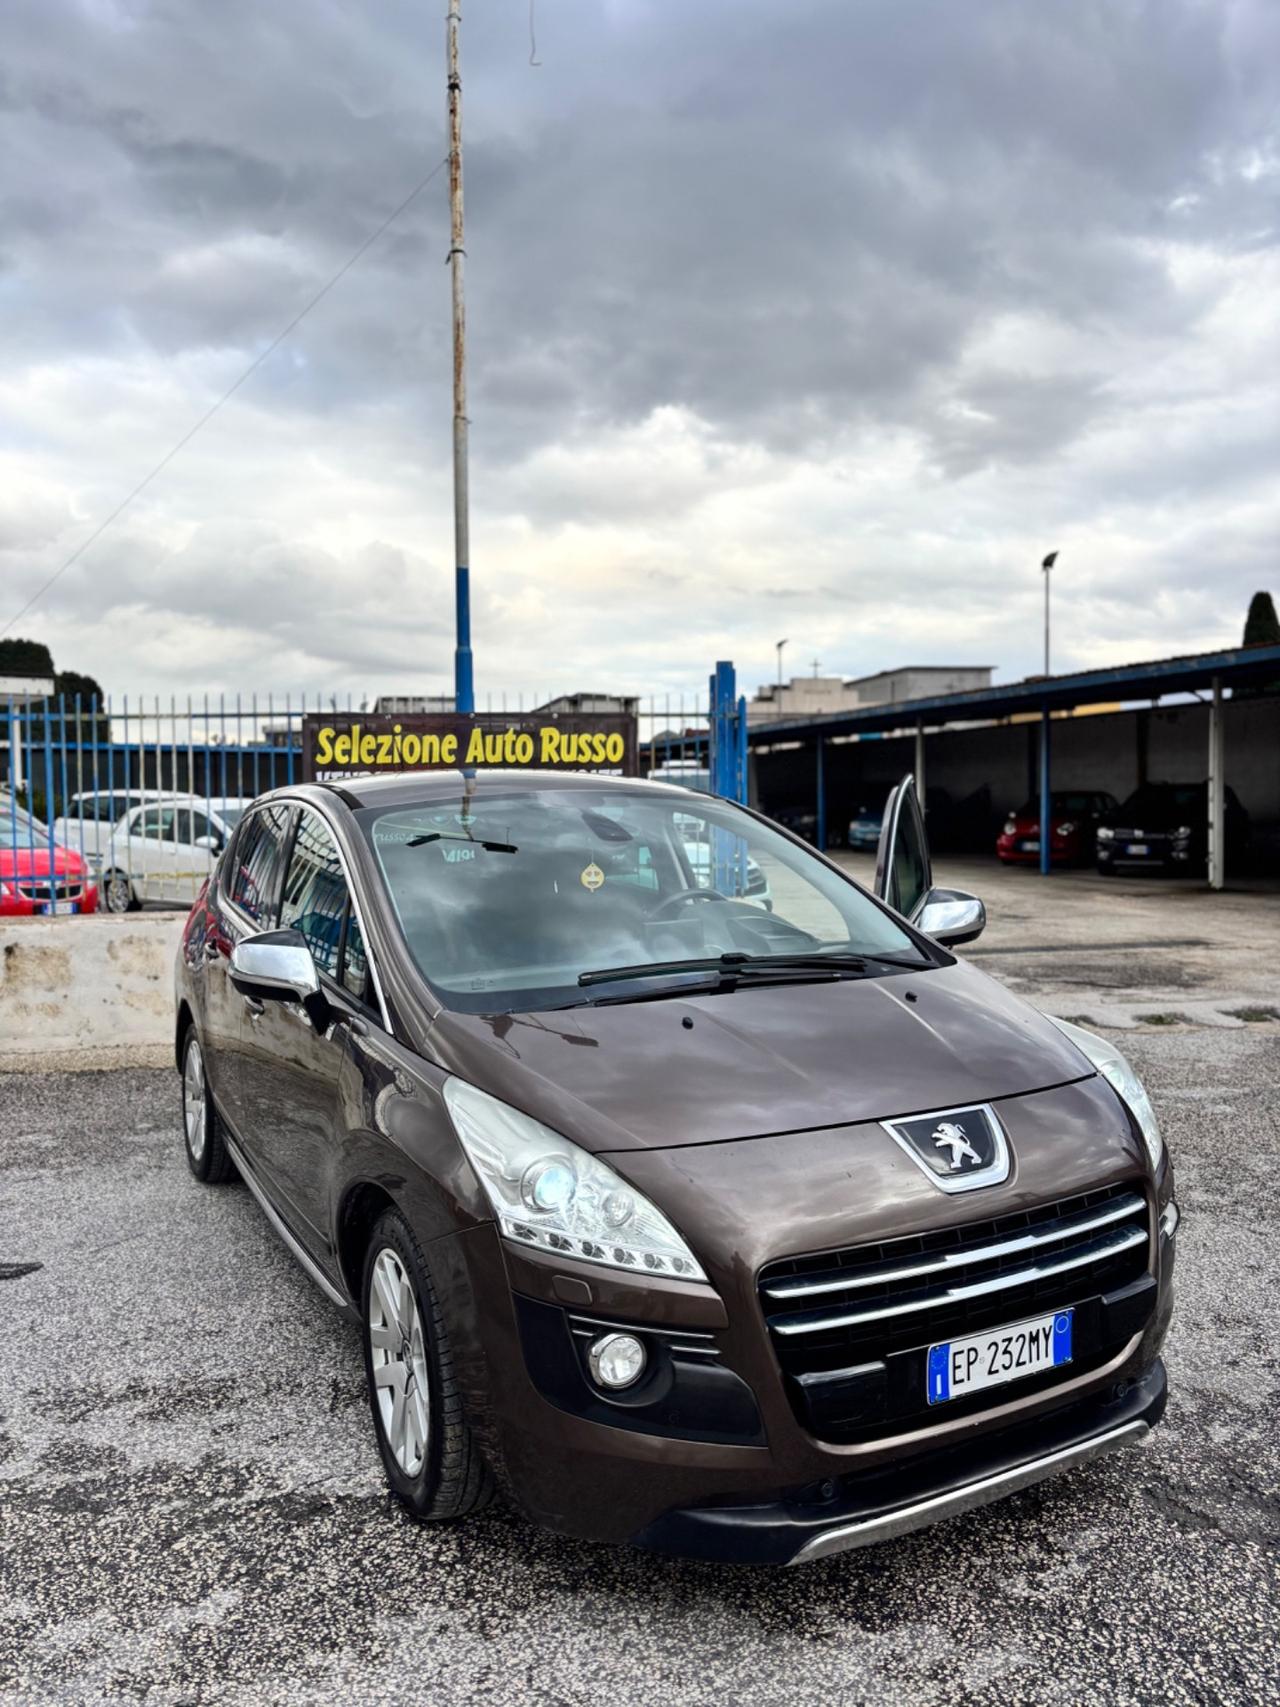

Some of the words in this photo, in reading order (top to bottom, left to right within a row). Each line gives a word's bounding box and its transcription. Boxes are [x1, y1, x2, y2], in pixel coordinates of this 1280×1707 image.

[315, 723, 457, 765] Selezione
[465, 727, 534, 765] Auto
[540, 726, 625, 763] Russo
[953, 1347, 978, 1385] EP
[987, 1325, 1053, 1375] 232MY
